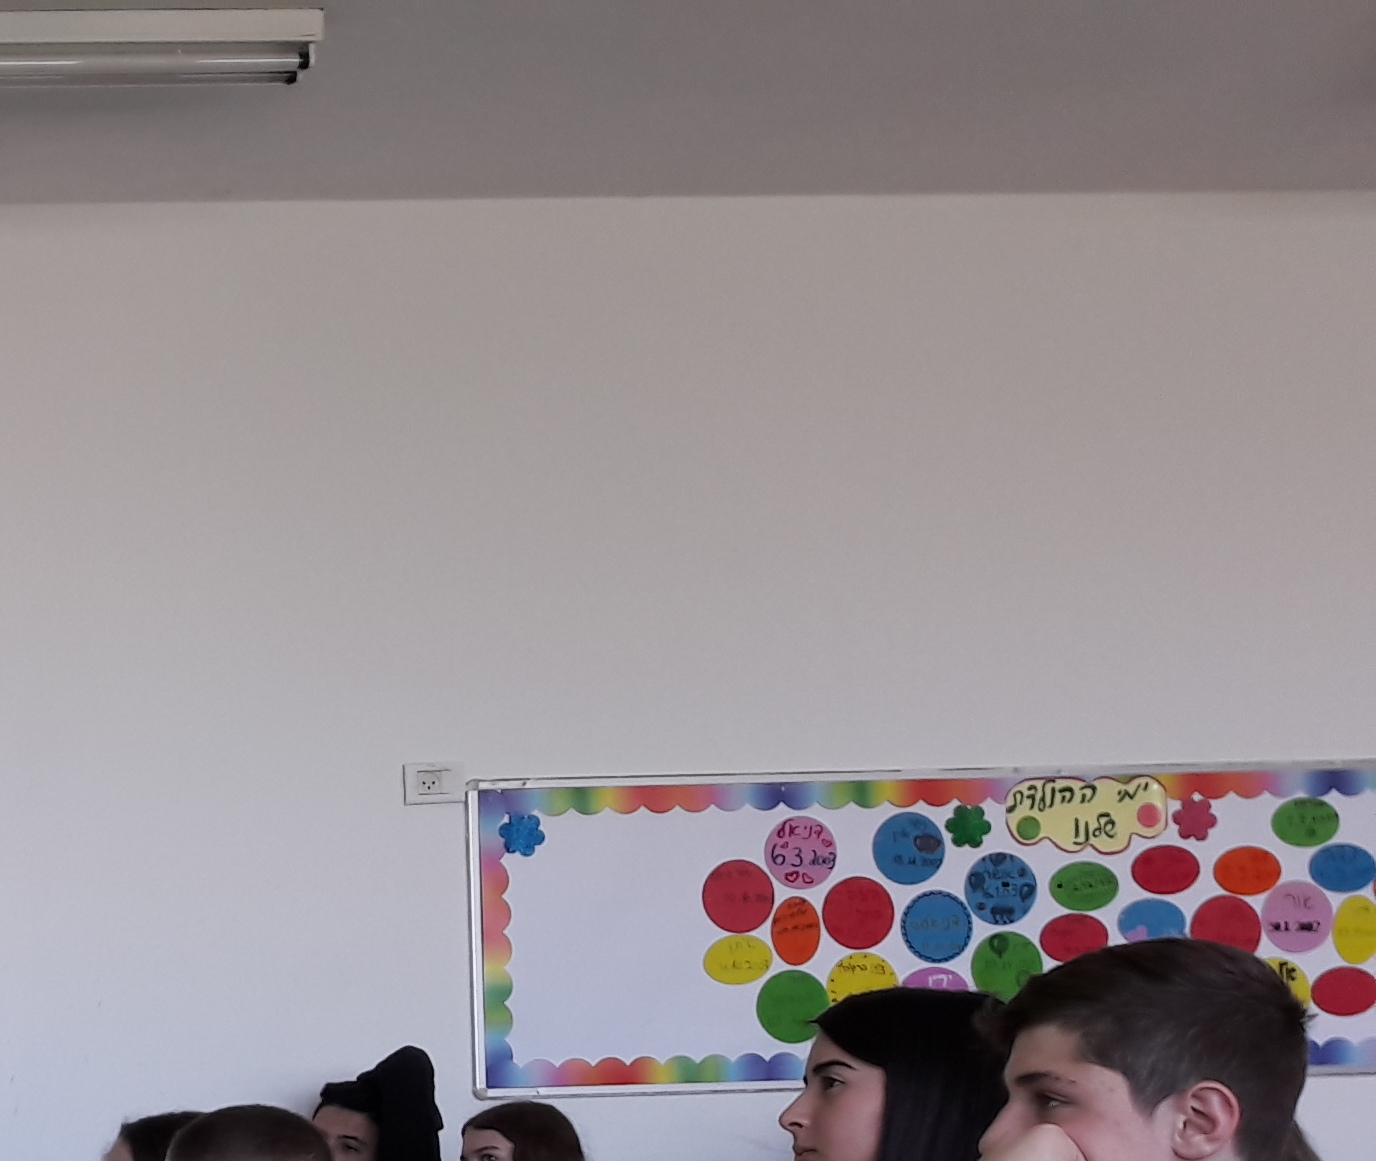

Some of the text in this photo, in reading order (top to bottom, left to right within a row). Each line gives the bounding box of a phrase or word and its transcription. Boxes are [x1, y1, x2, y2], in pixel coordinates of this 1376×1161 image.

[1005, 778, 1149, 813] ימי ההולדת
[776, 818, 824, 840] דניאל
[1073, 811, 1117, 845] שלנו
